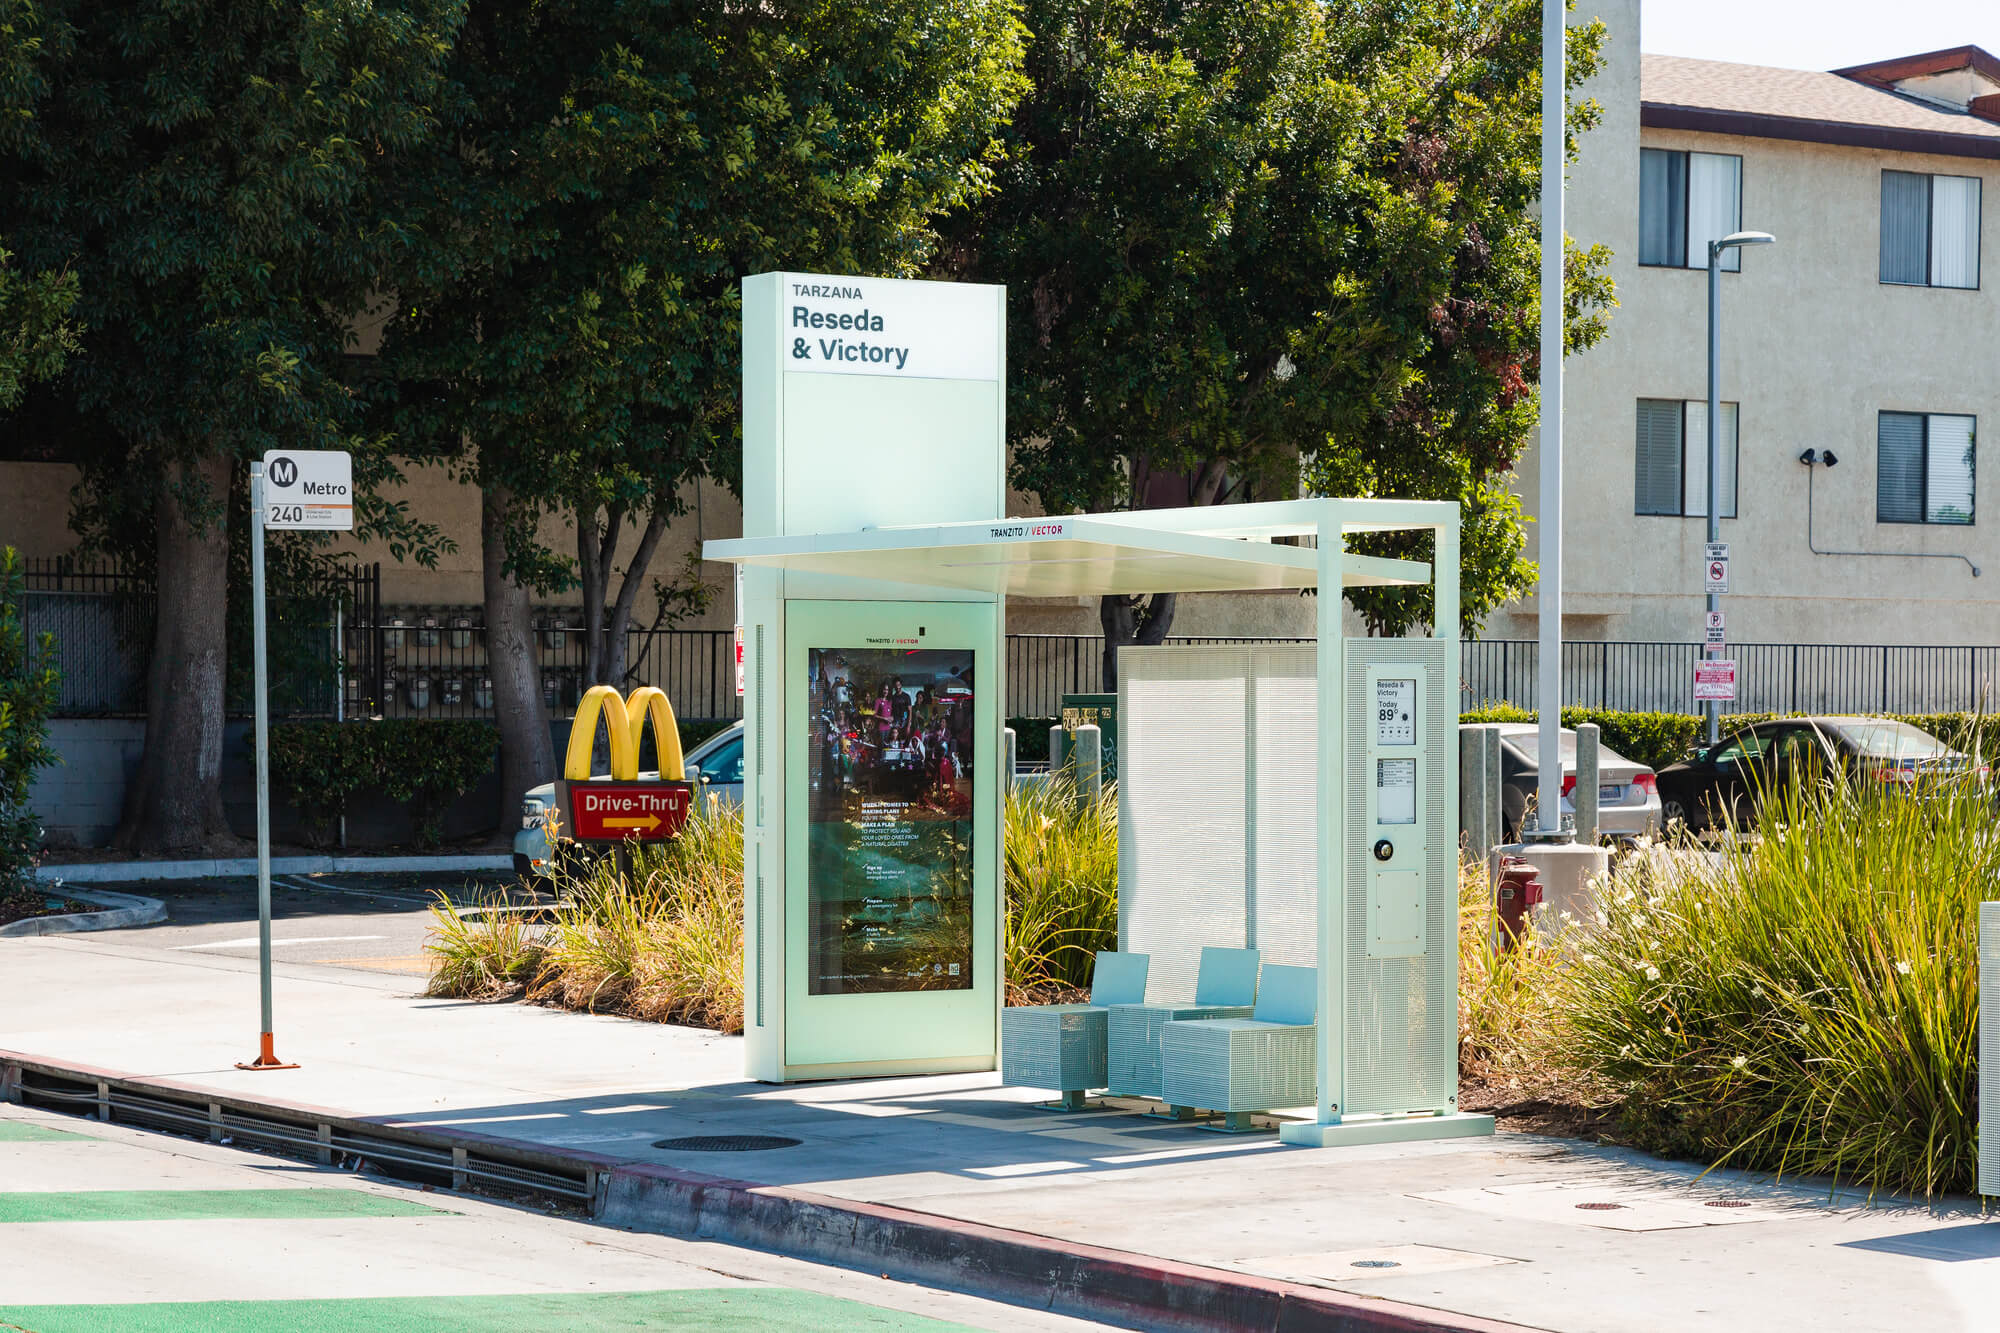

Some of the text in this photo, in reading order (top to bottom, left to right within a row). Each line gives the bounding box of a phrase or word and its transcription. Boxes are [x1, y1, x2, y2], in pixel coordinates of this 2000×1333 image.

[793, 284, 862, 299] TARZANA
[793, 306, 884, 332] Reseda
[792, 337, 908, 370] & Victory
[304, 482, 346, 495] Metro
[272, 506, 302, 522] 240
[990, 528, 1023, 538] TRANZITO
[1032, 525, 1062, 535] VECTOR
[586, 794, 678, 811] Drive-Thru
